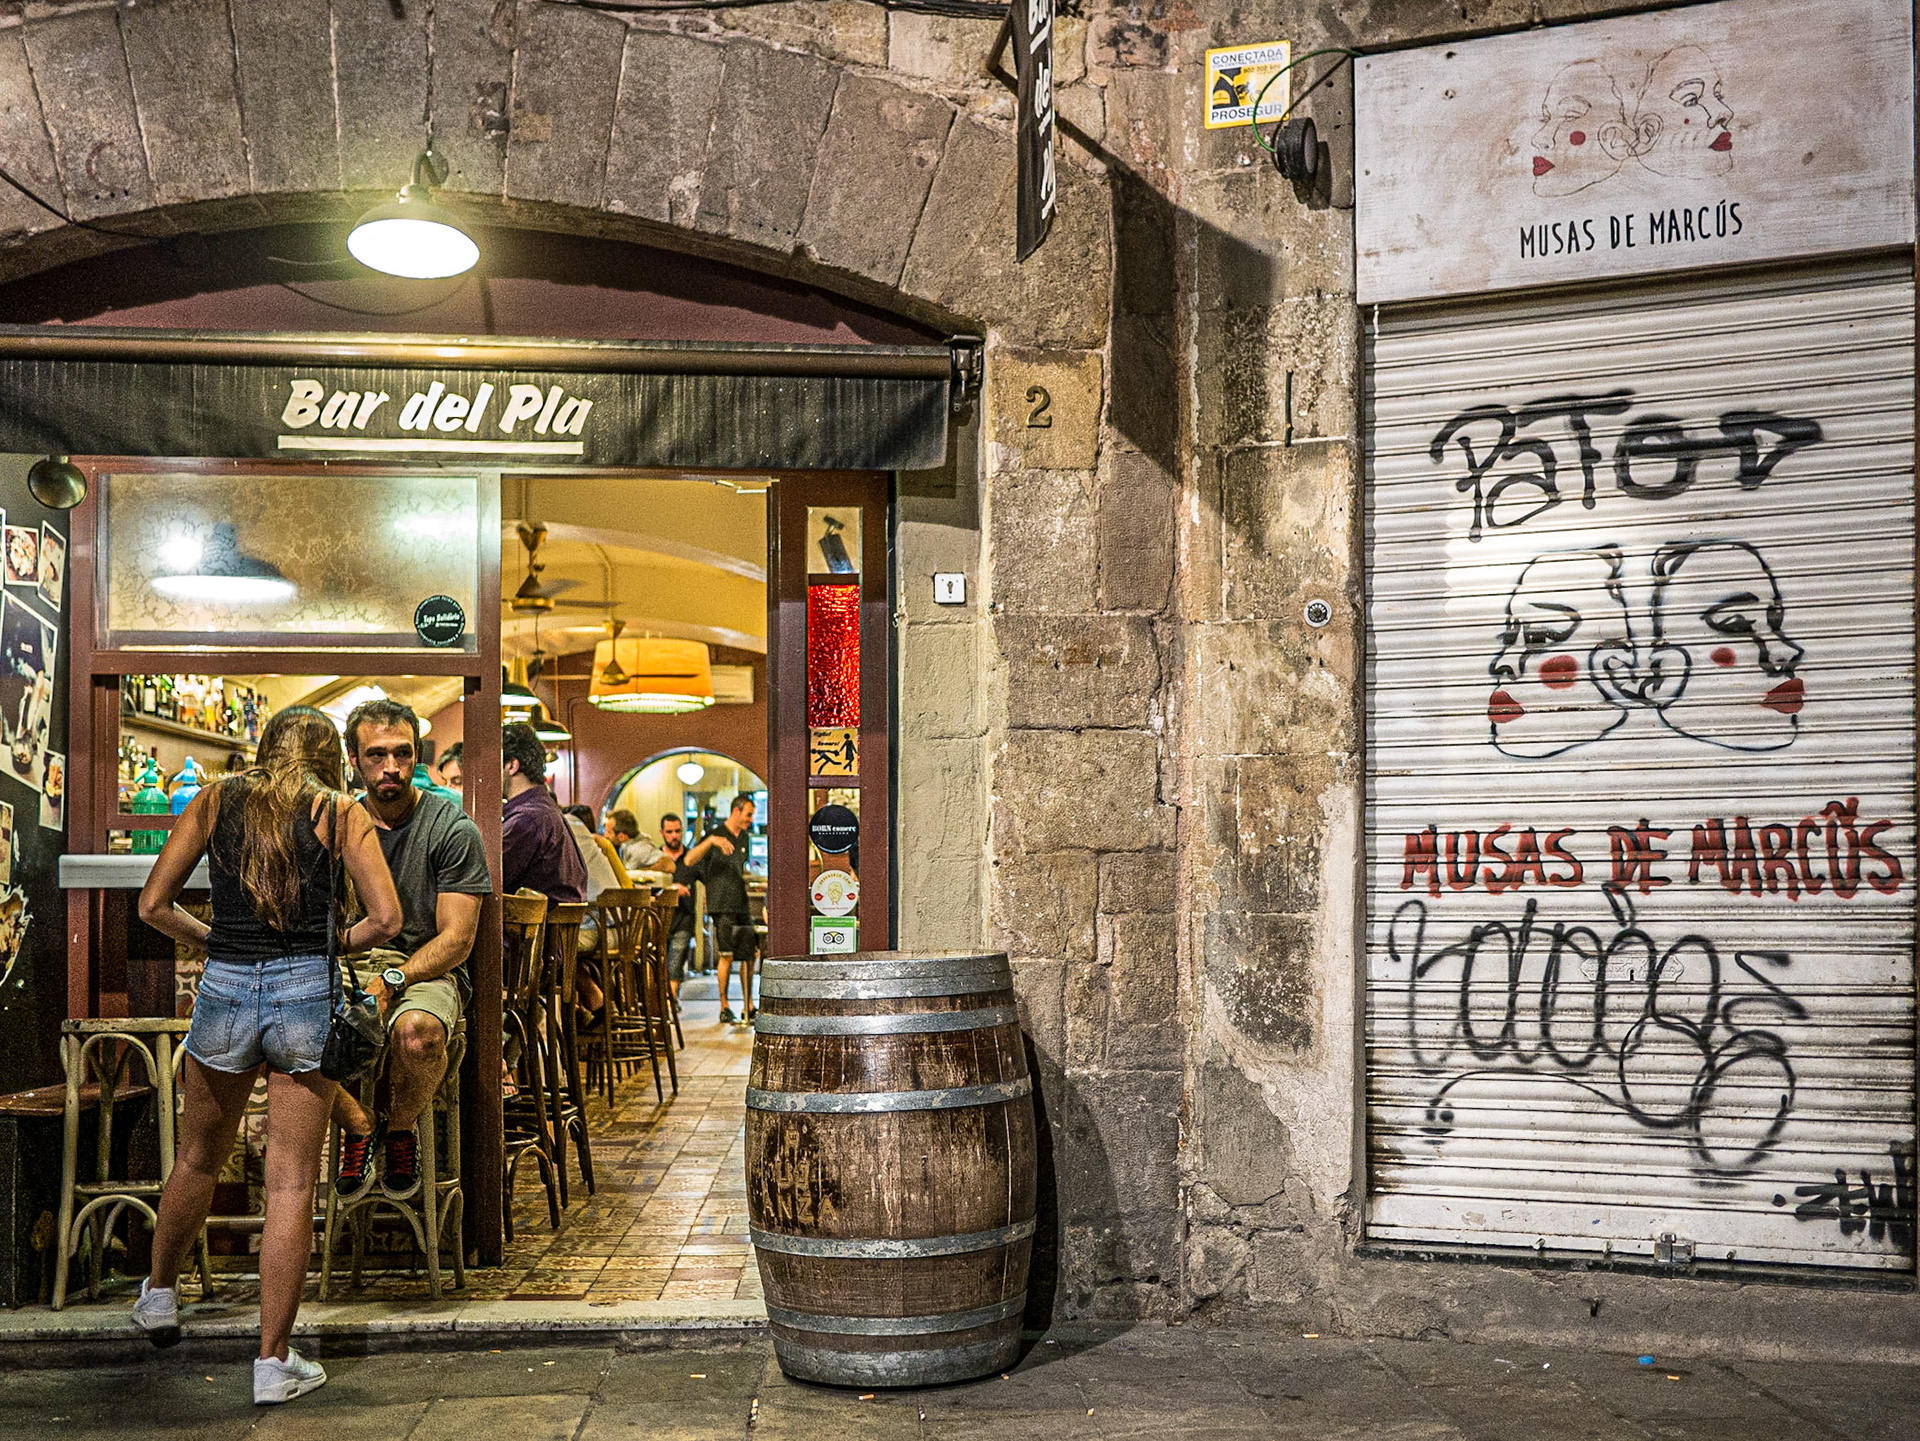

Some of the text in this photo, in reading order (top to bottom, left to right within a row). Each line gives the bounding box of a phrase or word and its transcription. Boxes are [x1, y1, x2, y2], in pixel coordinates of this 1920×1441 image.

[1212, 49, 1283, 65] CONECTADA
[1211, 104, 1283, 121] PROSEGUR
[1520, 199, 1743, 258] MUSAS DE MARCÚS
[281, 378, 593, 436] Bar del Pla
[1025, 385, 1053, 428] 2
[1400, 823, 1585, 898] MUSAS
[1607, 818, 1672, 895] DE
